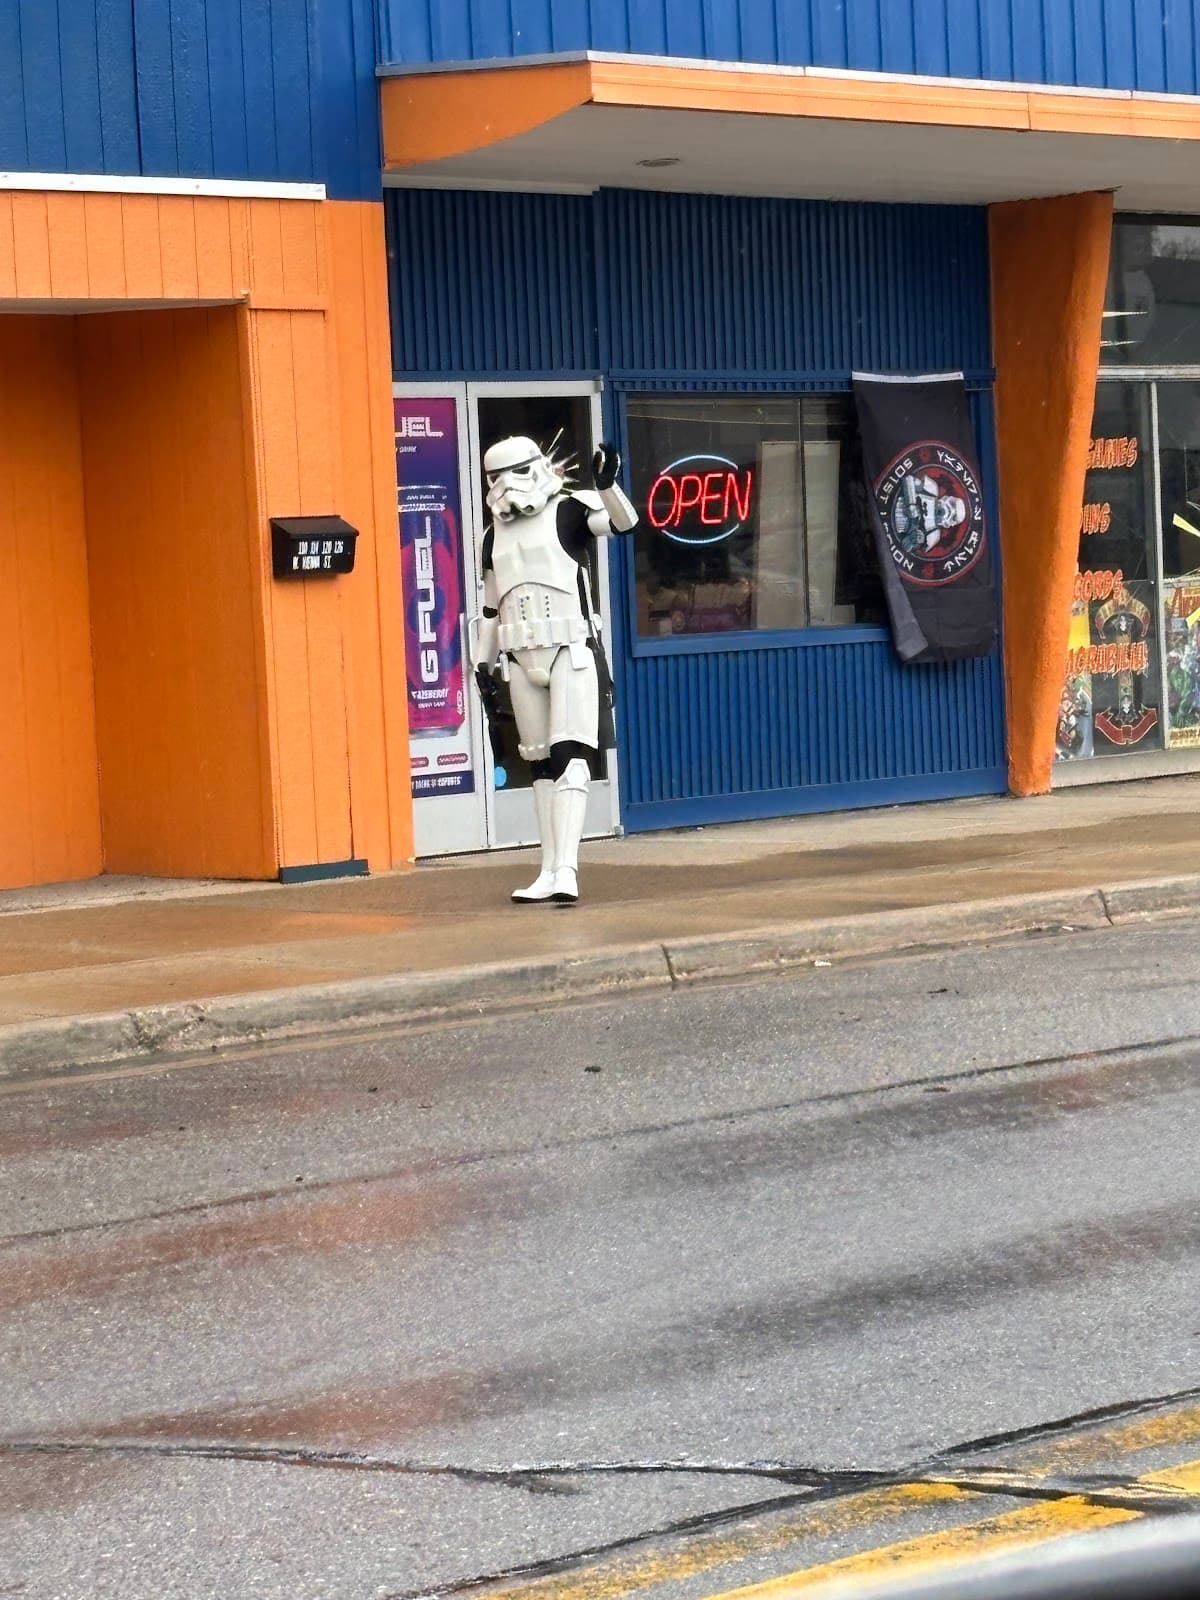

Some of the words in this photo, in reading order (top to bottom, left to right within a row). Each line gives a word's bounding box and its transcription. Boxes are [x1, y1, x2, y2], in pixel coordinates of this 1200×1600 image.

[395, 416, 444, 438] UEL
[648, 471, 751, 527] OPEN
[414, 515, 437, 643] FUEL
